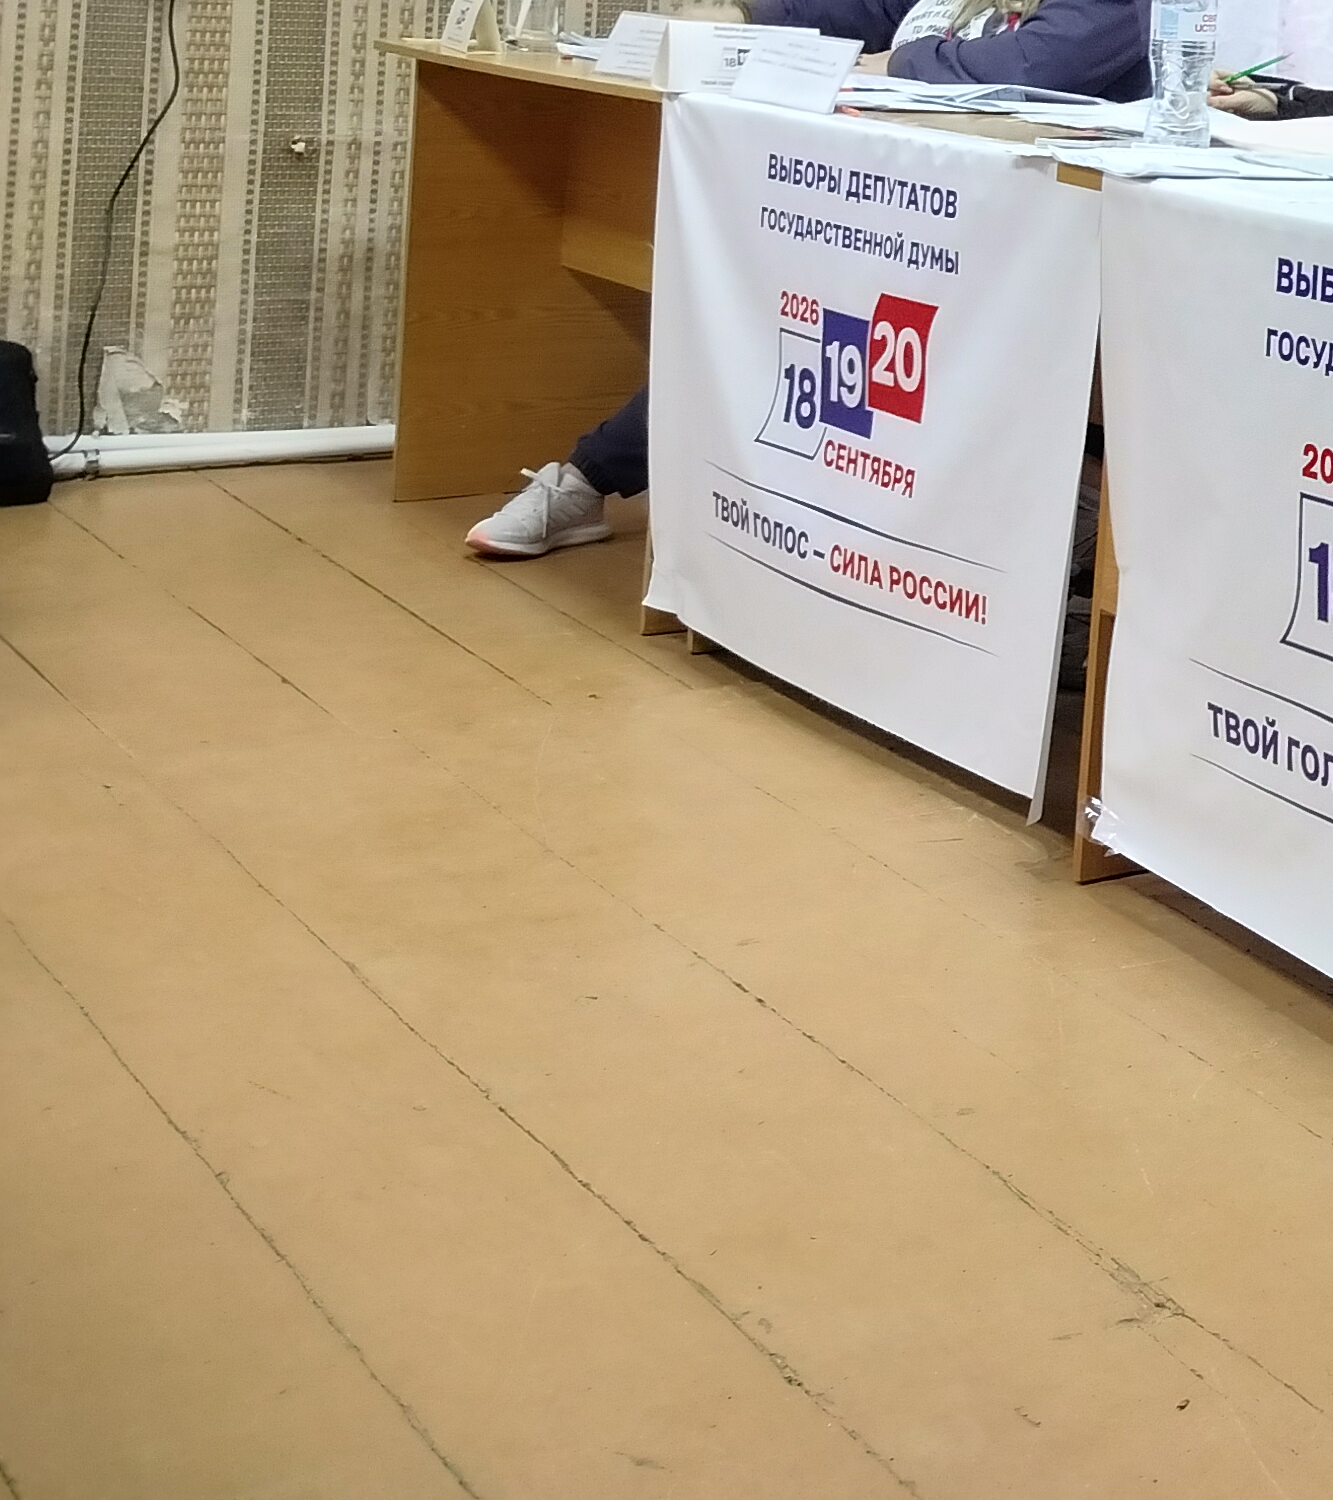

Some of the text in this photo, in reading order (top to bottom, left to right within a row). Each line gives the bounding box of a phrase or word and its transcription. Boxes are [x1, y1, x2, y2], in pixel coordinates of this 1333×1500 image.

[767, 153, 958, 219] ВЫБОРЫ ДЕПУТАТОВ
[760, 206, 959, 275] ГОСУДАРСТВЕННОЙ ДУМЫ
[780, 291, 819, 326] 2026
[783, 320, 923, 429] 18 19 20
[823, 440, 916, 498] СЕНТЯБРЯ
[712, 490, 751, 535] ТВОЙ
[753, 512, 810, 561] ГОЛОС
[829, 544, 884, 591] СИЛА
[888, 565, 988, 626] РОССИИ!
[1207, 702, 1279, 765] ТВОЙ
